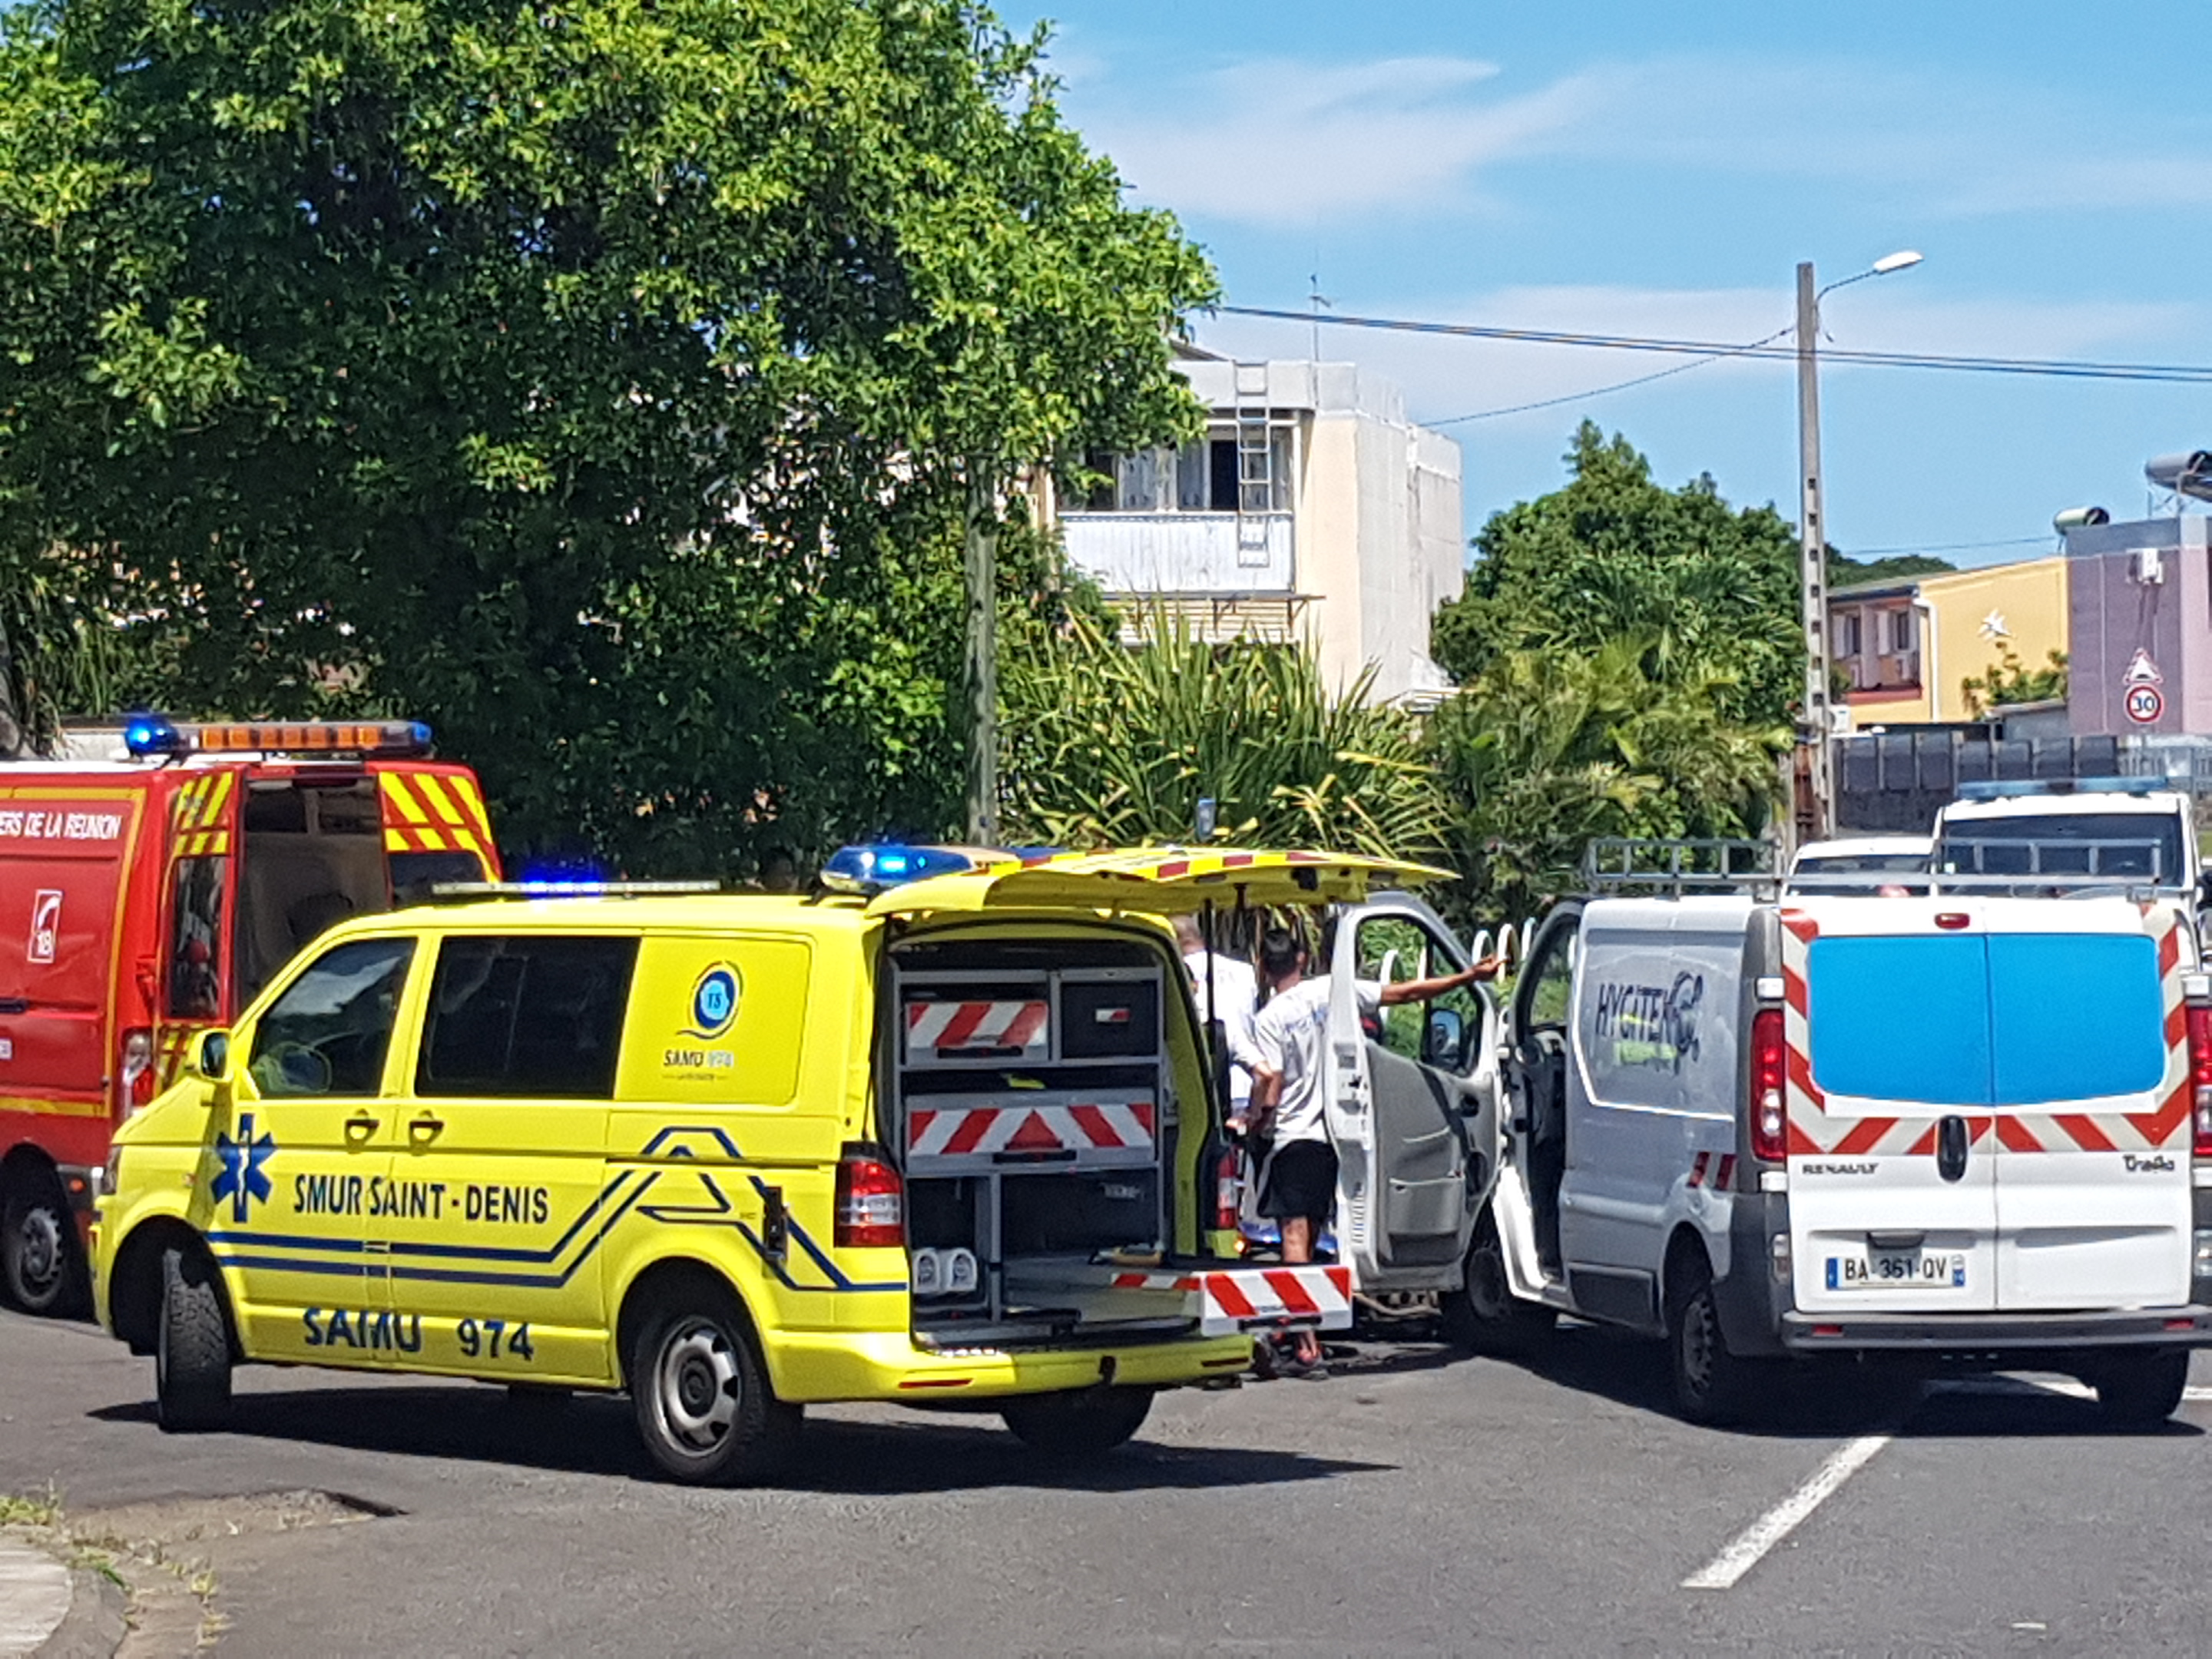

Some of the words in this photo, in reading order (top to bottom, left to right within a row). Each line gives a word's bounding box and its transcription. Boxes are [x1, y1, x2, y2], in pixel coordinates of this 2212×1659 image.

[2133, 695, 2155, 712] 30
[24, 812, 45, 838] DE
[45, 813, 63, 838] LA
[37, 929, 52, 955] 18
[664, 1049, 704, 1068] SAMU
[1802, 1162, 1879, 1175] RENAULT
[293, 1173, 363, 1216] SMUR
[303, 1306, 422, 1353] SAMU
[456, 1317, 535, 1362] 974
